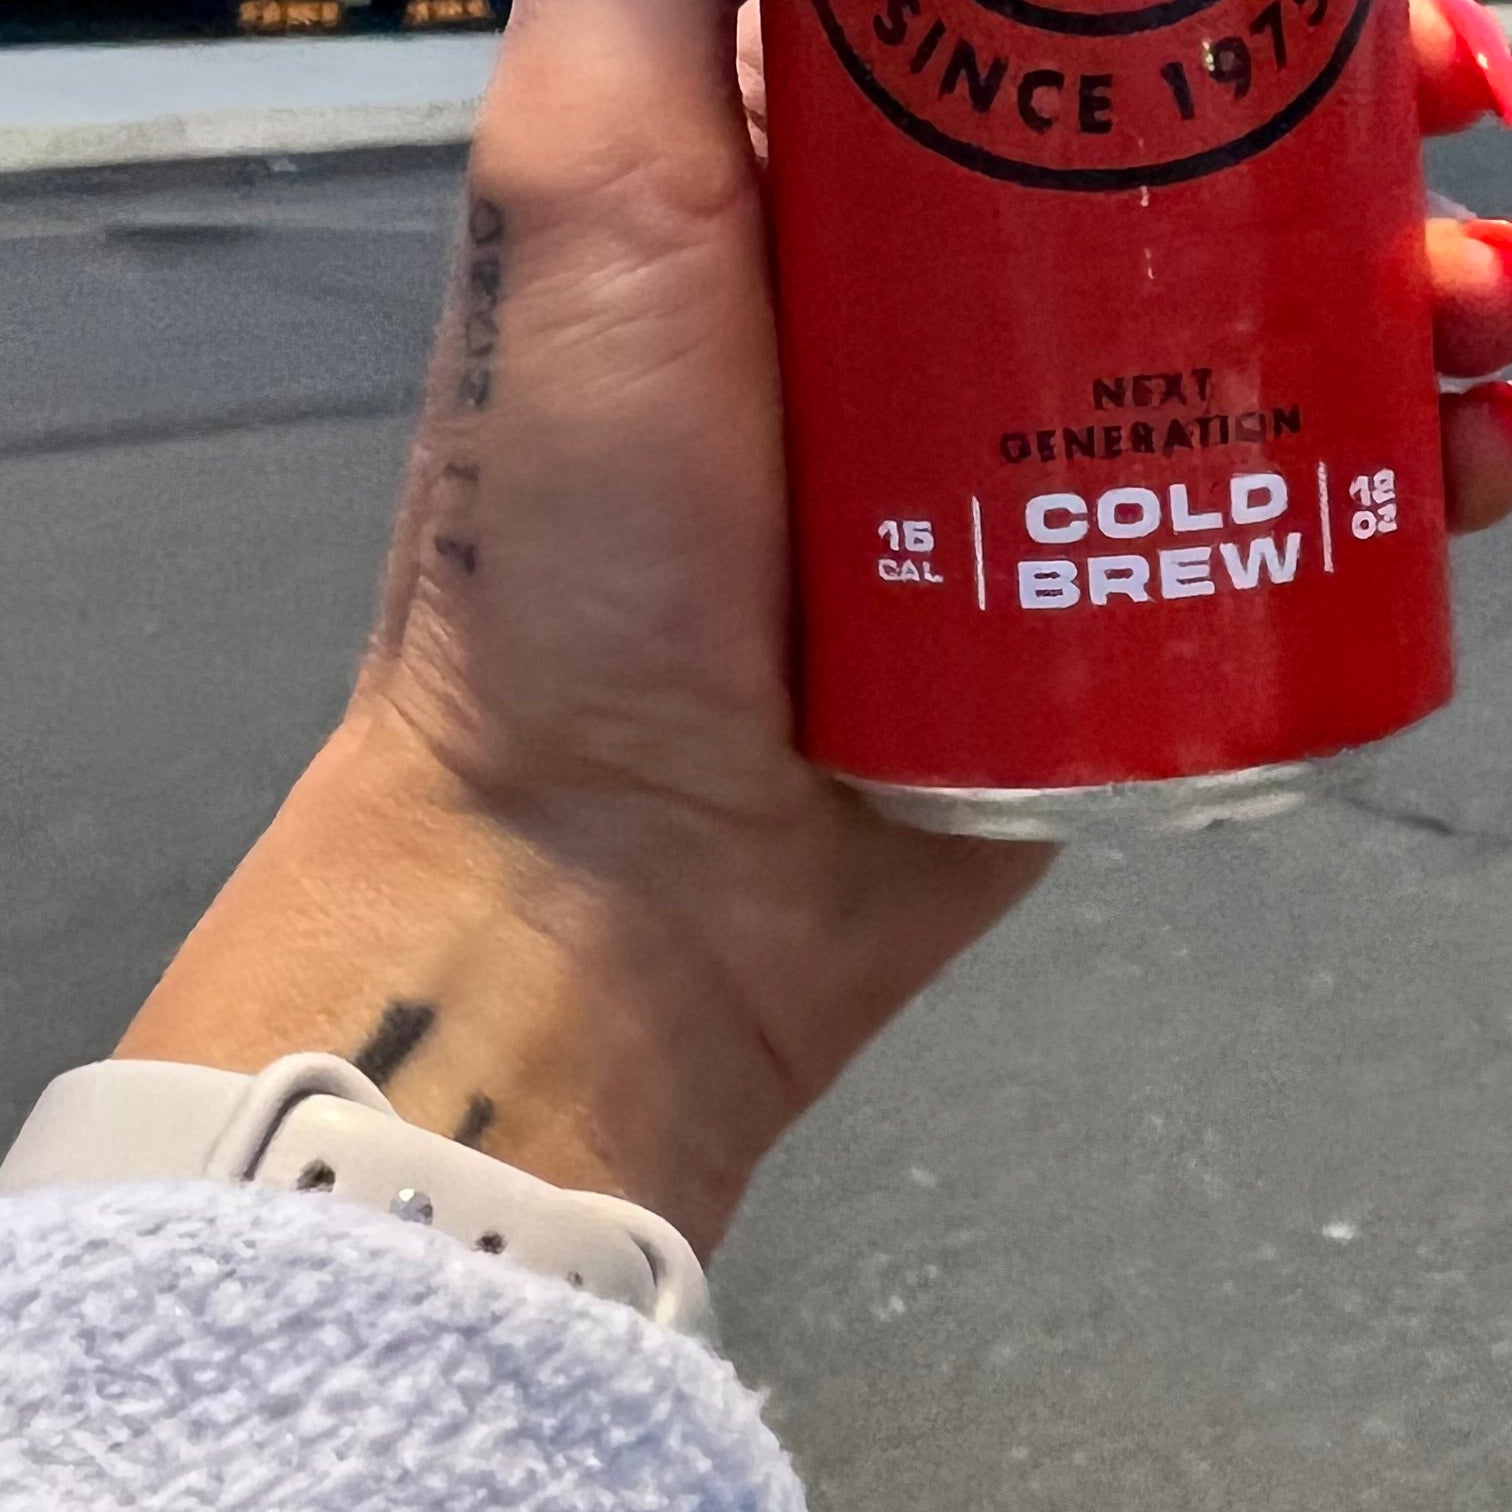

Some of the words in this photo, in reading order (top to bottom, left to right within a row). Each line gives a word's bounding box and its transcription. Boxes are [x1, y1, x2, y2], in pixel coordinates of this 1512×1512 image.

[1092, 367, 1213, 411] NEXT
[1001, 404, 1301, 464] GENERATION
[1025, 472, 1288, 544] COLD
[878, 558, 944, 583] CAL
[1018, 531, 1302, 610] BREW
